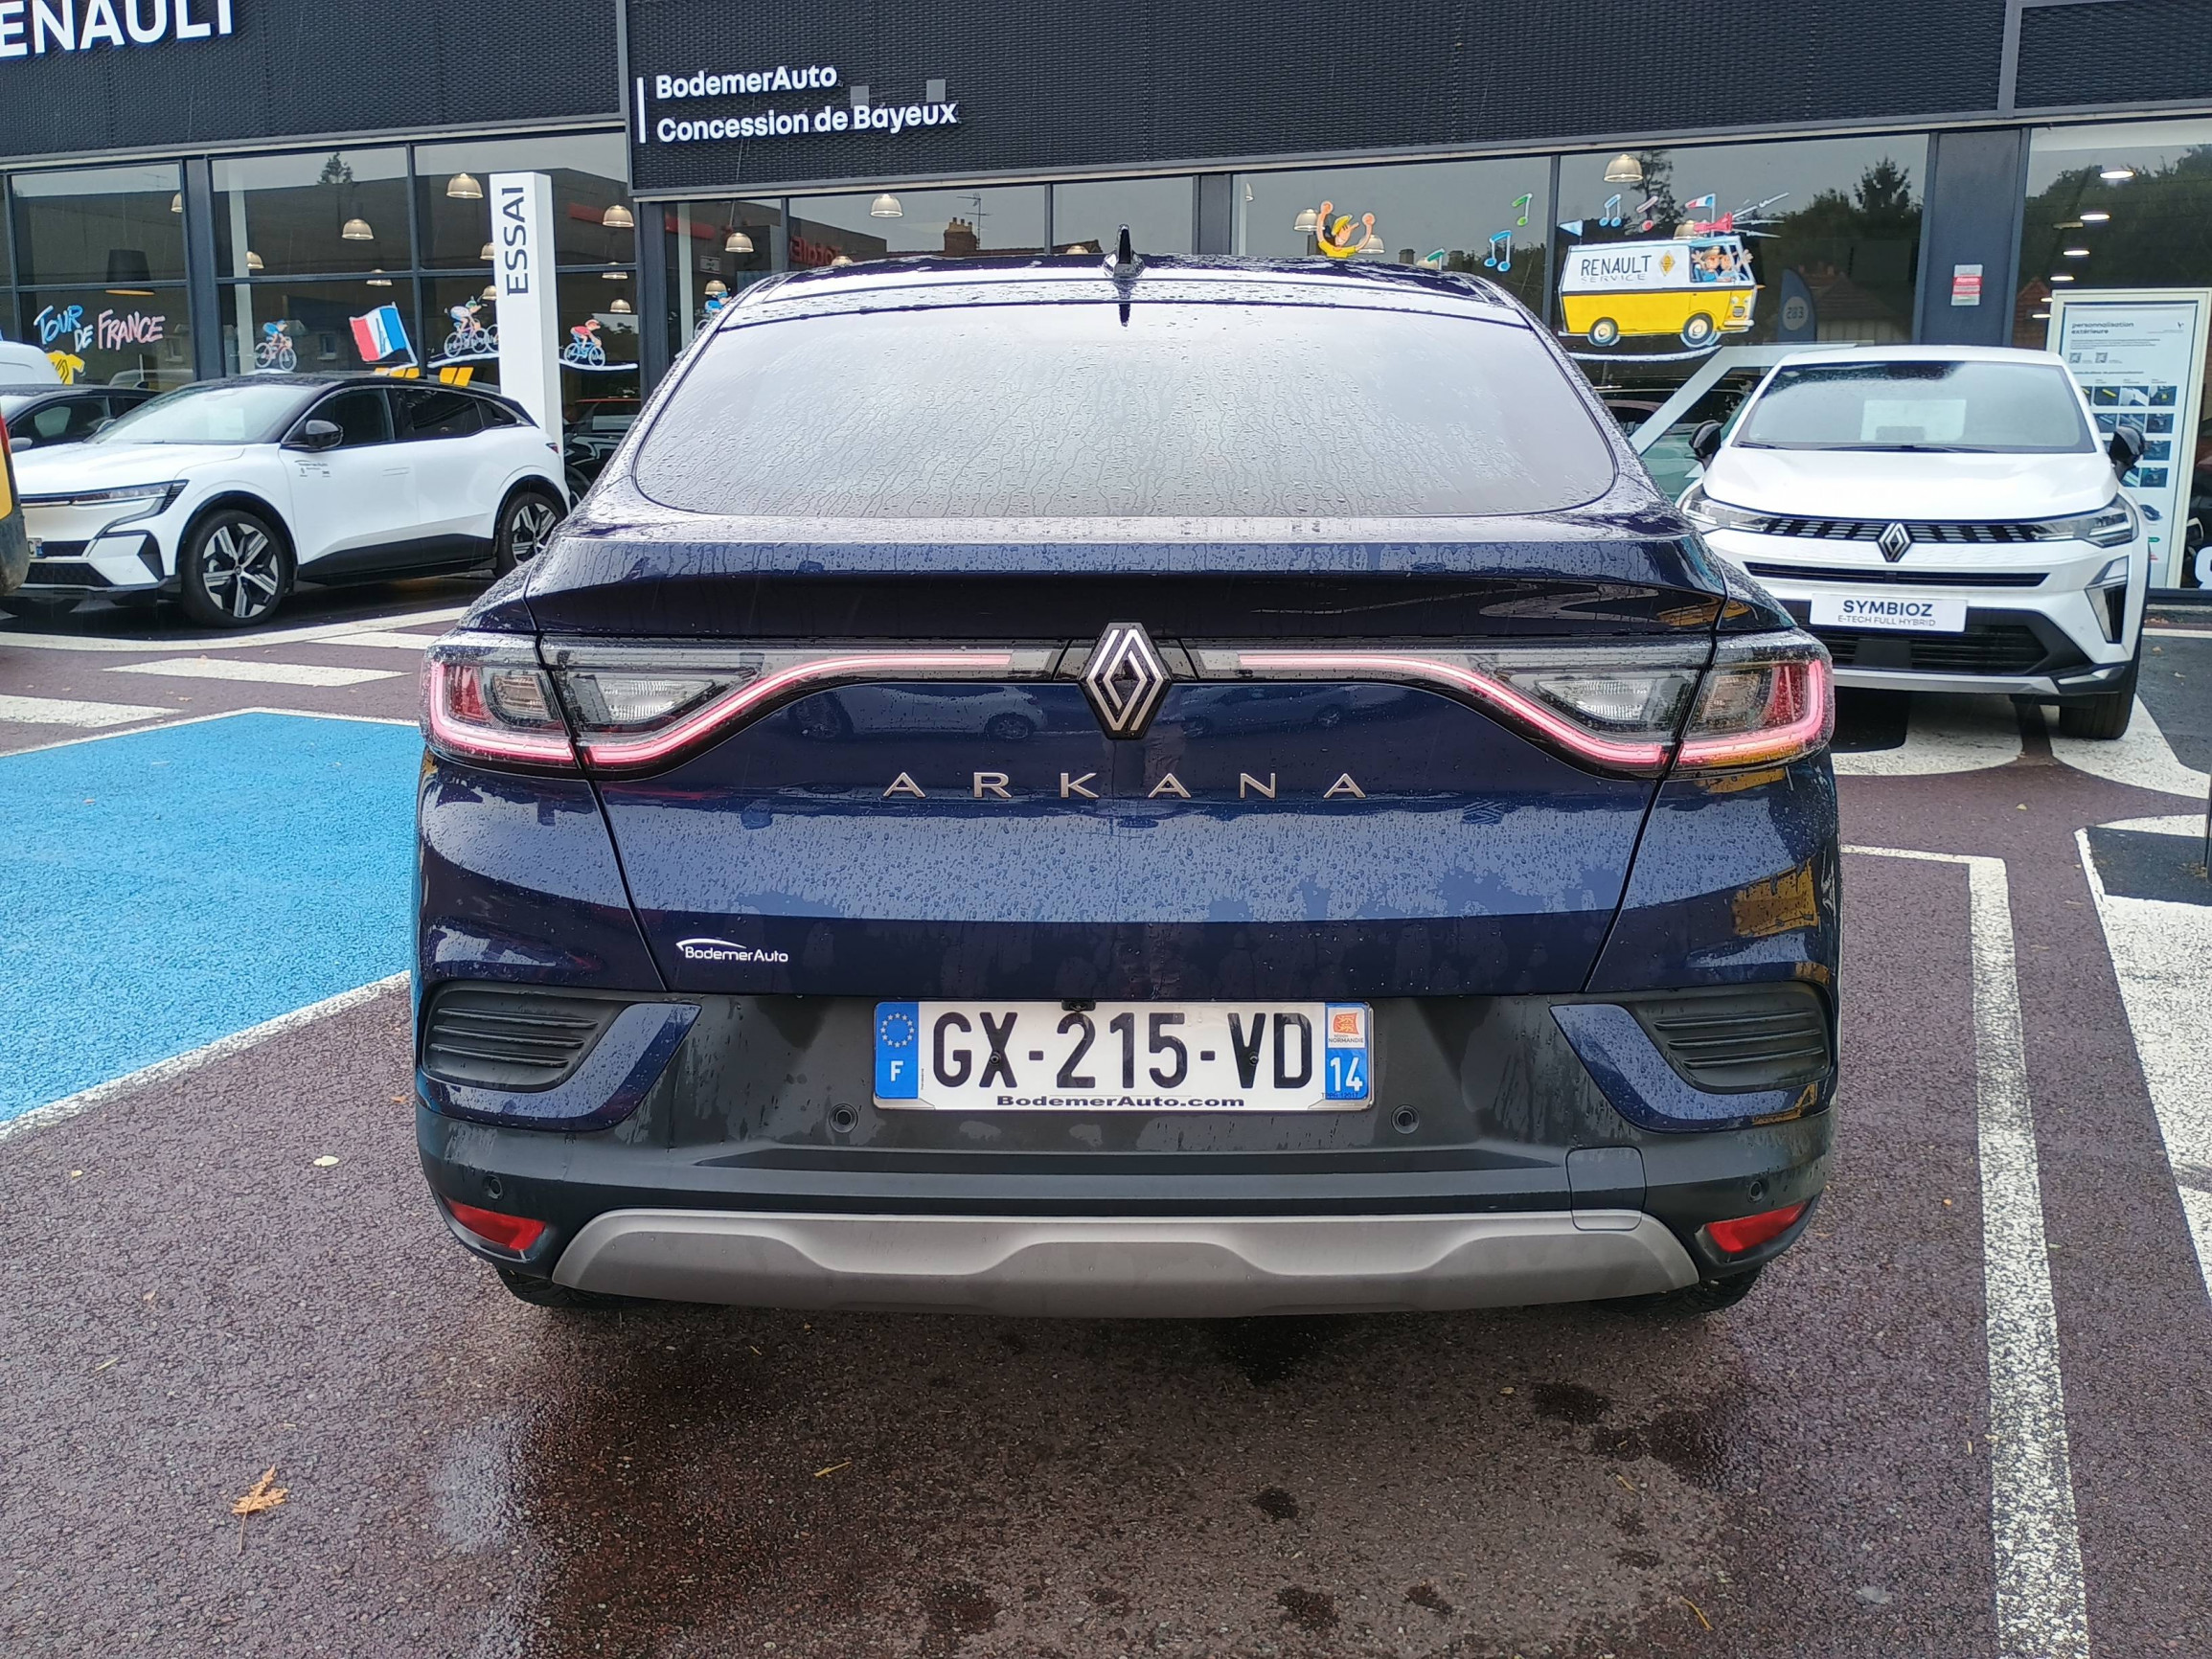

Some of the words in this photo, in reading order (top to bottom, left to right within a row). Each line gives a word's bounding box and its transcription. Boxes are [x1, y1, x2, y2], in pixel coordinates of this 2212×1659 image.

[655, 64, 838, 100] BodemerAuto
[656, 109, 810, 143] Concession
[813, 105, 849, 133] de
[853, 102, 958, 134] Bayeux
[501, 187, 529, 296] ESSAI
[1580, 254, 1653, 277] RENAULT
[1580, 273, 1647, 284] SERVICE
[33, 305, 83, 345] TOUR
[75, 324, 94, 353] DE
[98, 308, 166, 352] FRANCE
[2071, 321, 2134, 330] personnalisation
[1837, 614, 1872, 624] E-TECH
[1874, 617, 1897, 625] FULL
[1899, 618, 1936, 626] HYBRID
[1842, 600, 1933, 617] SYMBIOZ
[881, 771, 1367, 799] ARKANA
[684, 945, 789, 963] BodemerAuto
[932, 1011, 1313, 1089] GX-215-VD
[890, 1059, 904, 1082] F
[1330, 1057, 1363, 1092] 14
[996, 1095, 1245, 1107] BodemerAuto.com
